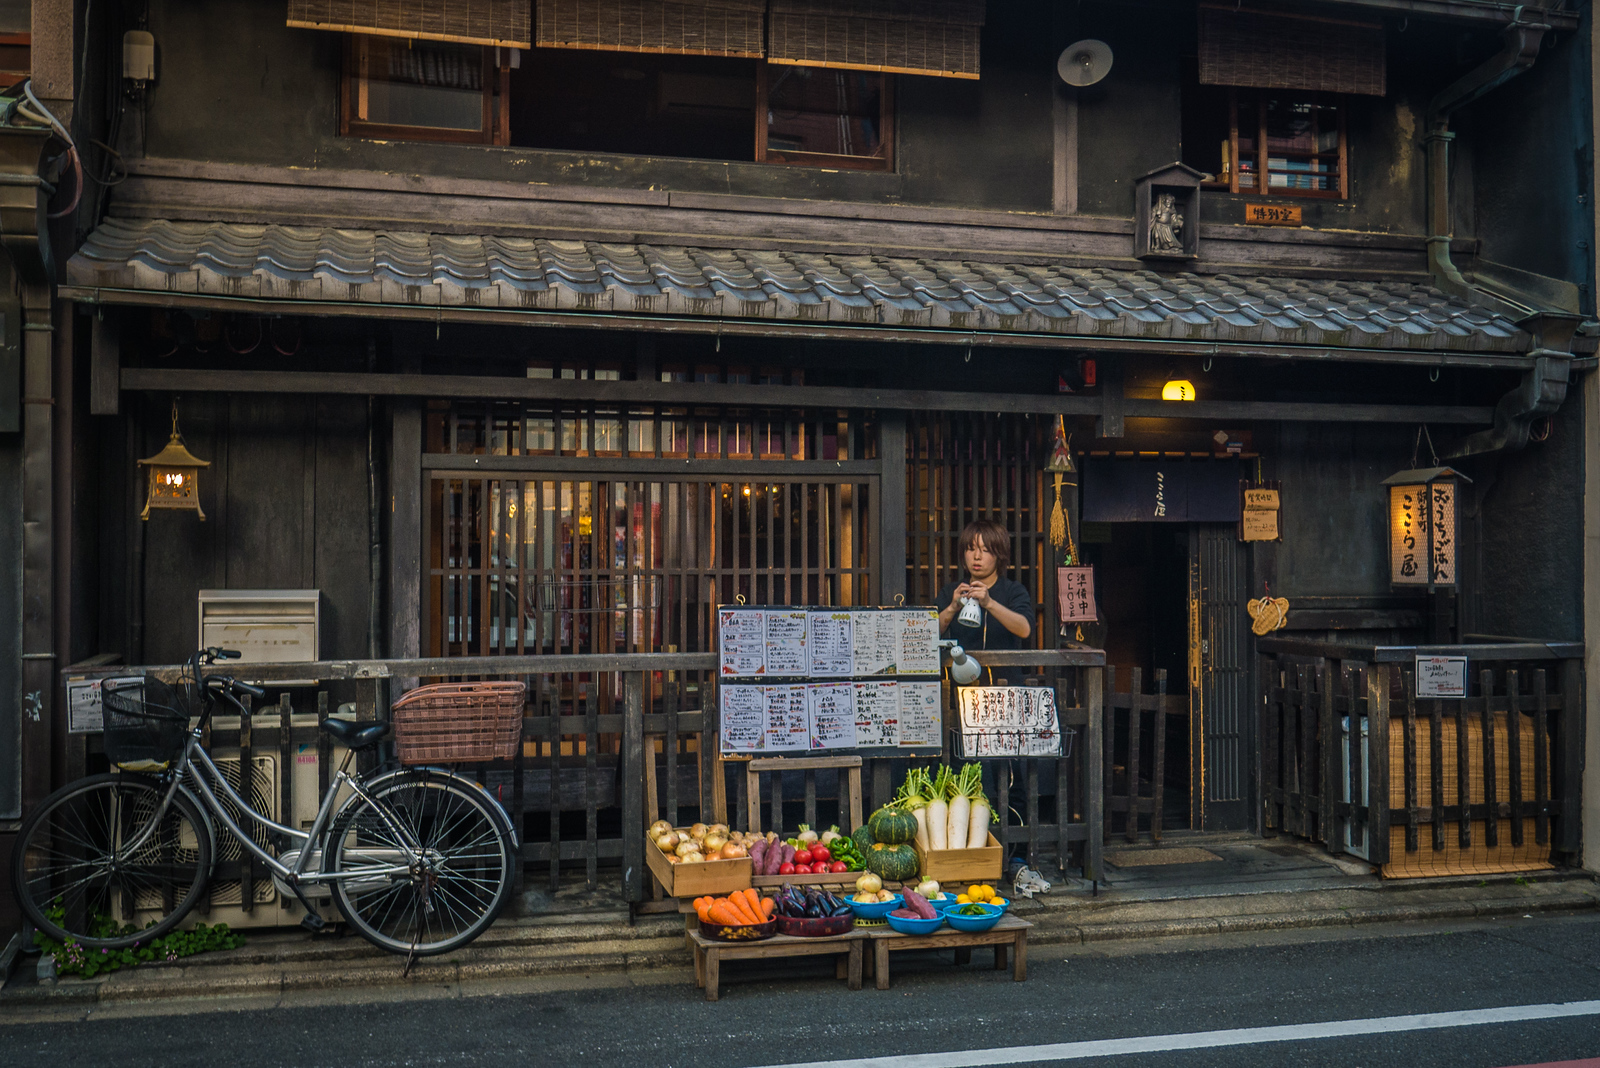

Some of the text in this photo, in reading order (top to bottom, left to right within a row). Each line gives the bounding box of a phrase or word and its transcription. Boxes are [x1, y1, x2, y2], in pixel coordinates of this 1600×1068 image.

[1252, 207, 1295, 222] 特別室
[1154, 471, 1166, 517] ここら屋
[1400, 494, 1418, 577] ここら屋
[1433, 487, 1451, 580] おうちごはん
[1067, 572, 1075, 617] CLOSE
[1075, 572, 1089, 615] 準備中
